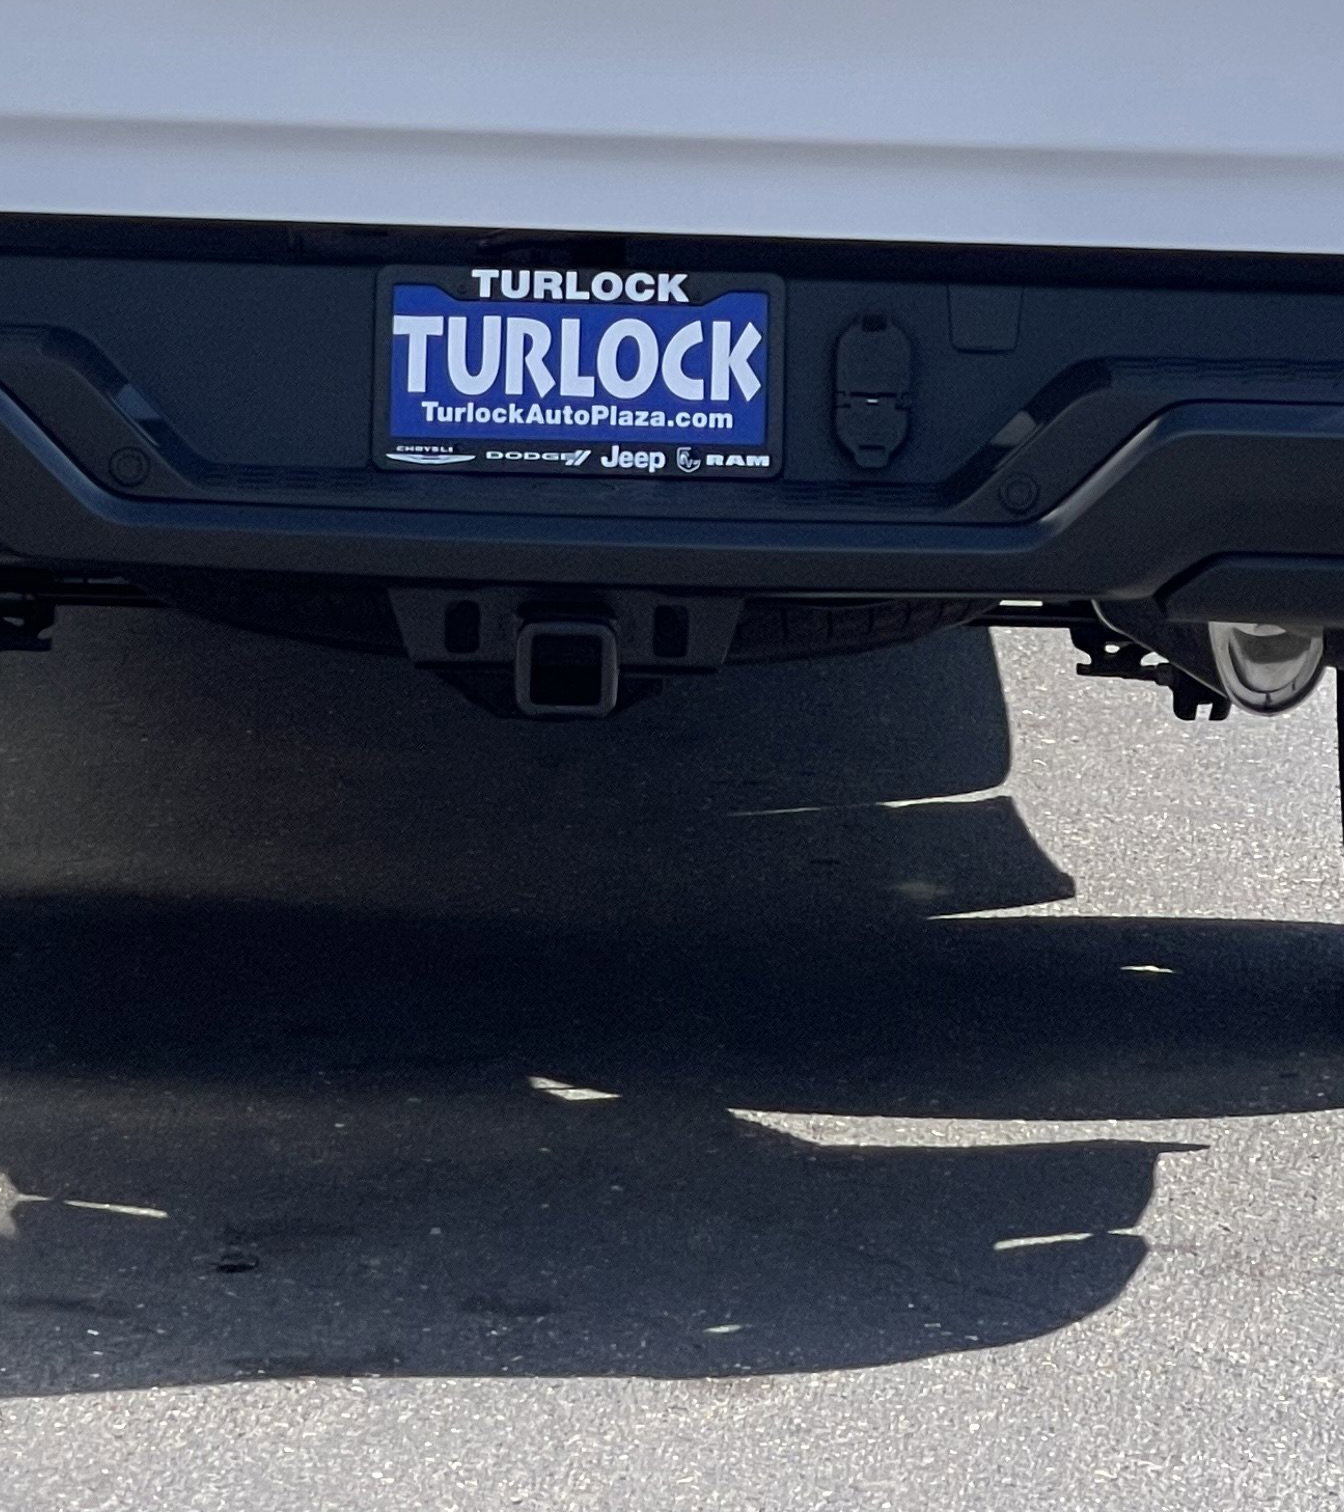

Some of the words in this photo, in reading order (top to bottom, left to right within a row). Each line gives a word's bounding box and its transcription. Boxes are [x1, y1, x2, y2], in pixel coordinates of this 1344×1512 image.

[471, 268, 690, 303] TURLOCK
[392, 314, 763, 402] TURLOCK
[421, 401, 734, 430] TurlockAutoPlaza.com
[600, 444, 666, 473] Jeep
[706, 454, 770, 467] RAM
